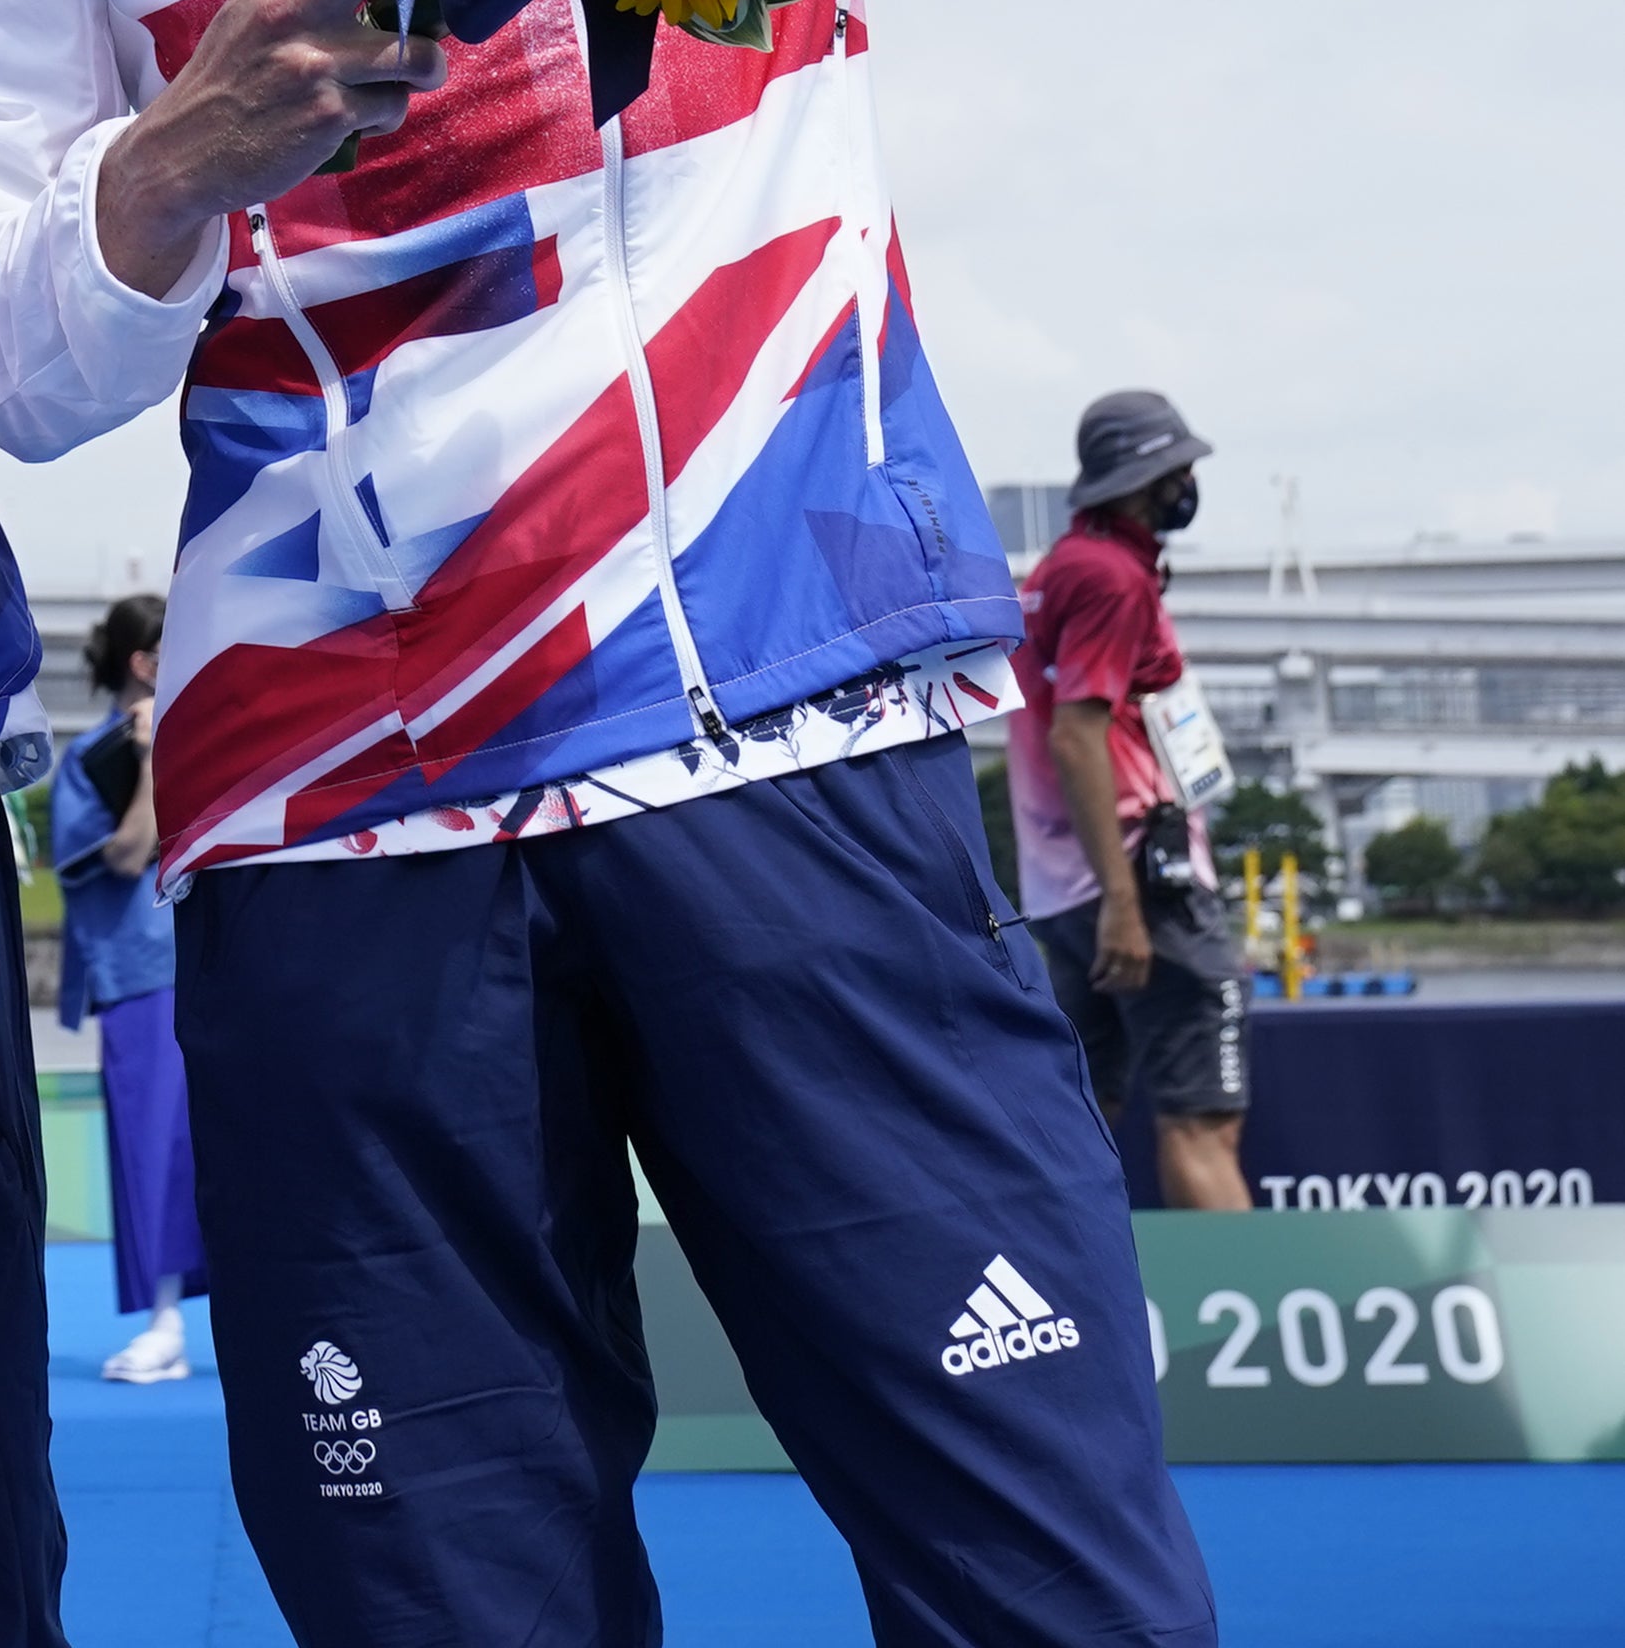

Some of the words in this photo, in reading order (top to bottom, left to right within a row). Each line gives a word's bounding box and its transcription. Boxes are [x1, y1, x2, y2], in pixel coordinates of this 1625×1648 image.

[1260, 1172, 1446, 1211] TOKYO
[1456, 1168, 1593, 1209] 2020
[941, 1315, 1080, 1376] adidas
[1198, 1285, 1503, 1388] 2020
[302, 1413, 347, 1432] TEAM
[351, 1409, 382, 1430] GB
[320, 1484, 354, 1497] TOKYO
[355, 1481, 383, 1496] 2020
